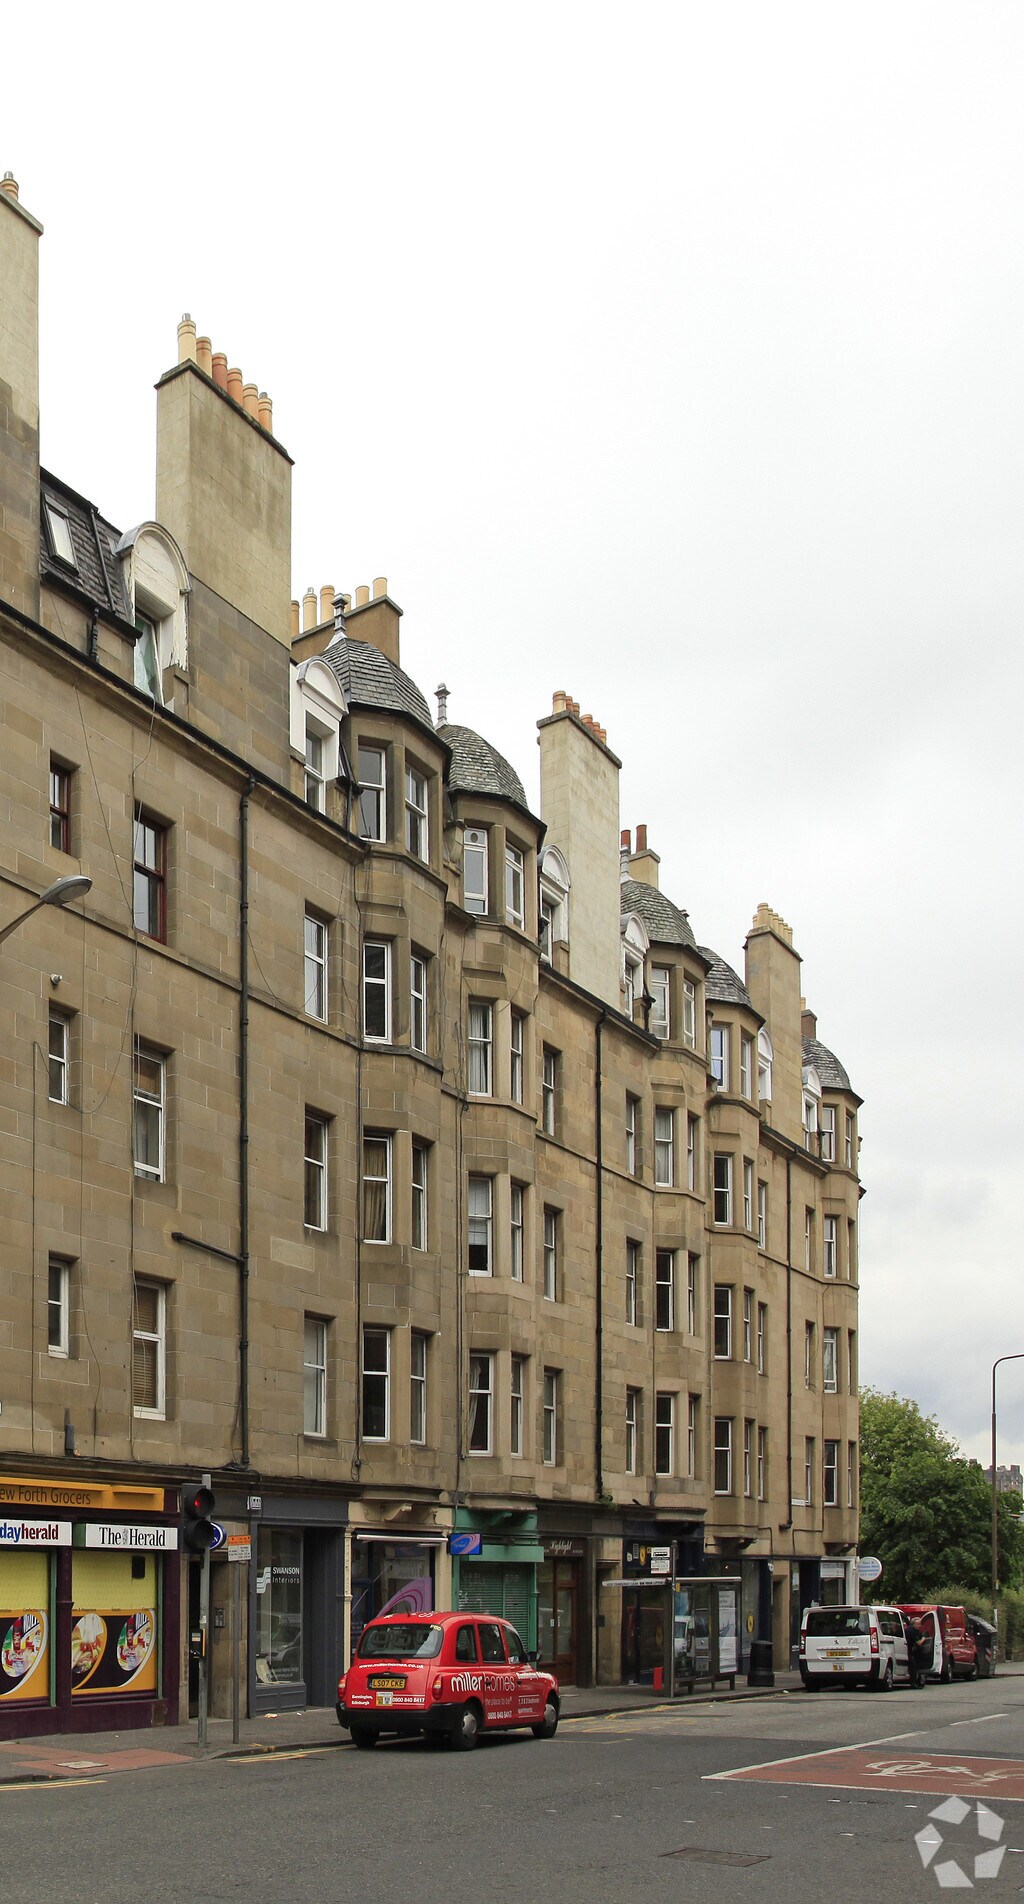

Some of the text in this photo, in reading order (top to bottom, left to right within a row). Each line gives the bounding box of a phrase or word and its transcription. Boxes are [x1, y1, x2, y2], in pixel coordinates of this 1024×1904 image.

[18, 1485, 48, 1503] Forth
[50, 1488, 91, 1505] Grocers
[98, 1527, 166, 1547] The Herald
[272, 1567, 300, 1575] SWANSON
[450, 1672, 515, 1692] miller homes
